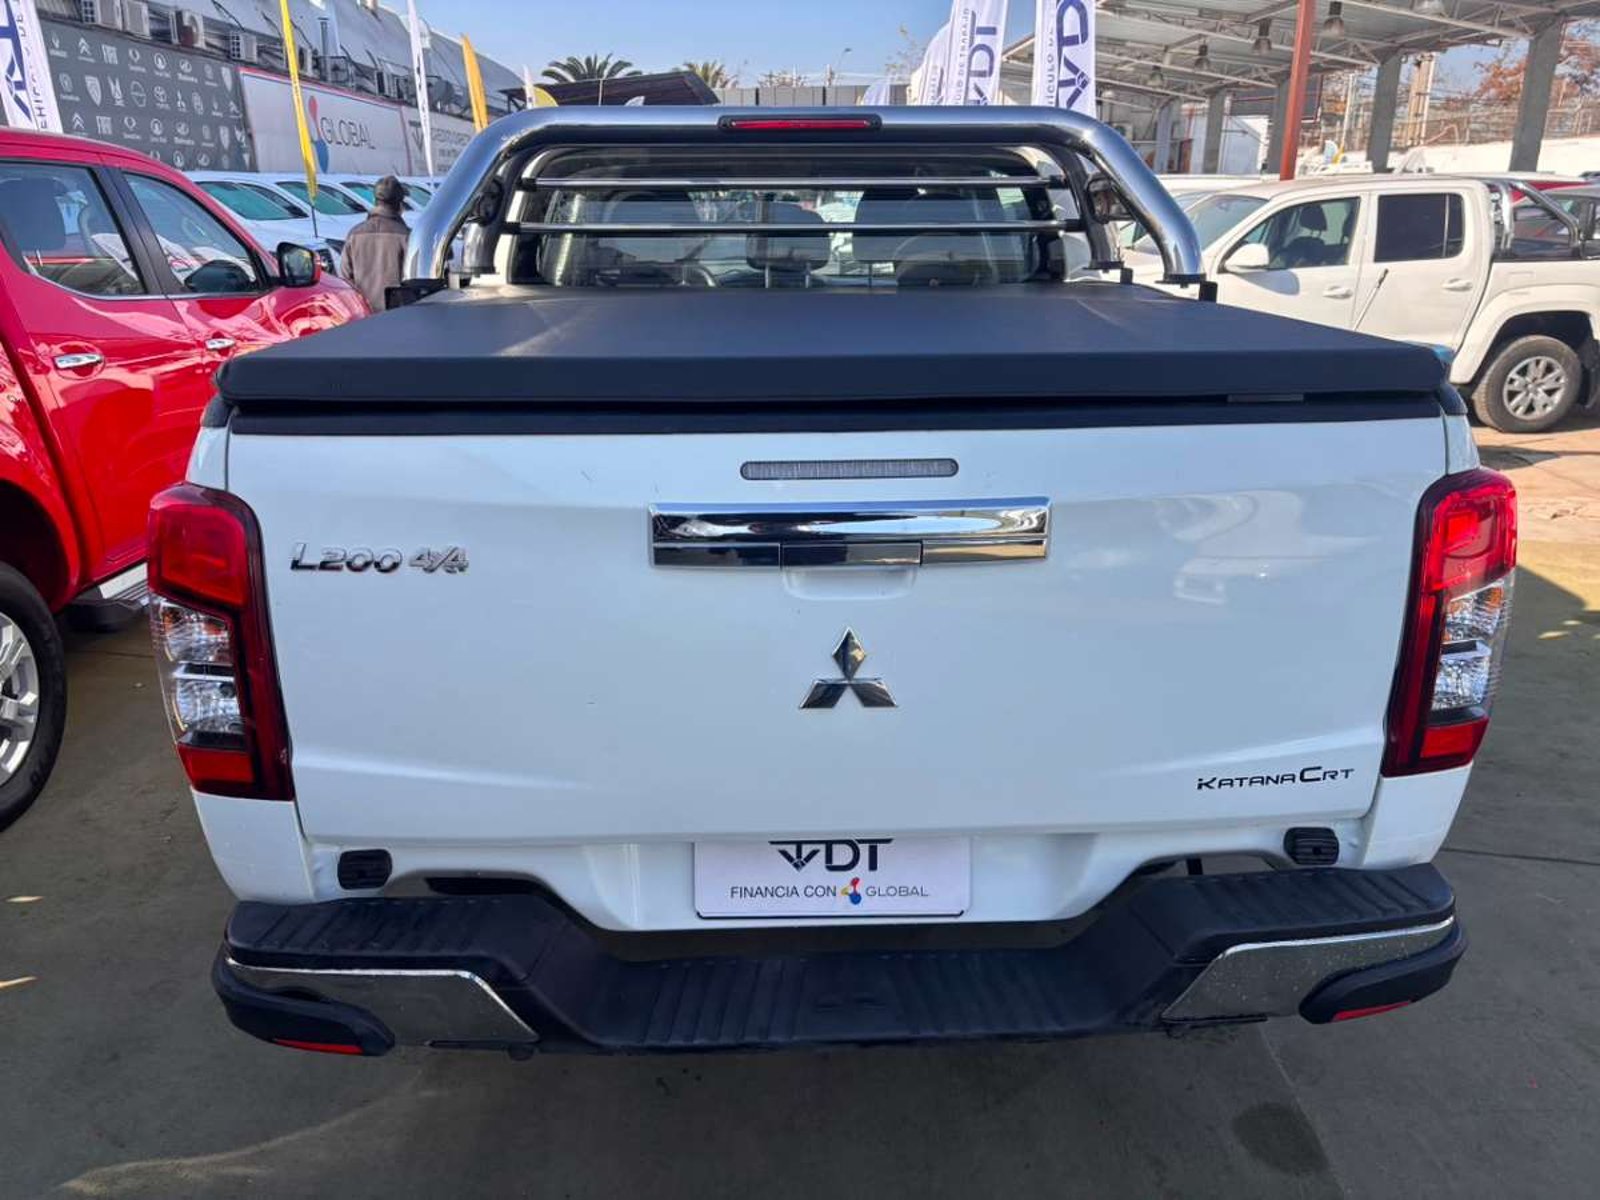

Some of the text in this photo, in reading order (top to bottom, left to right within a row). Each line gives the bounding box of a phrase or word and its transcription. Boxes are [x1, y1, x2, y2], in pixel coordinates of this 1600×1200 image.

[320, 117, 376, 150] GLOBAL
[289, 542, 404, 574] L200
[730, 885, 929, 899] FINANCIA CON GLOBAL
